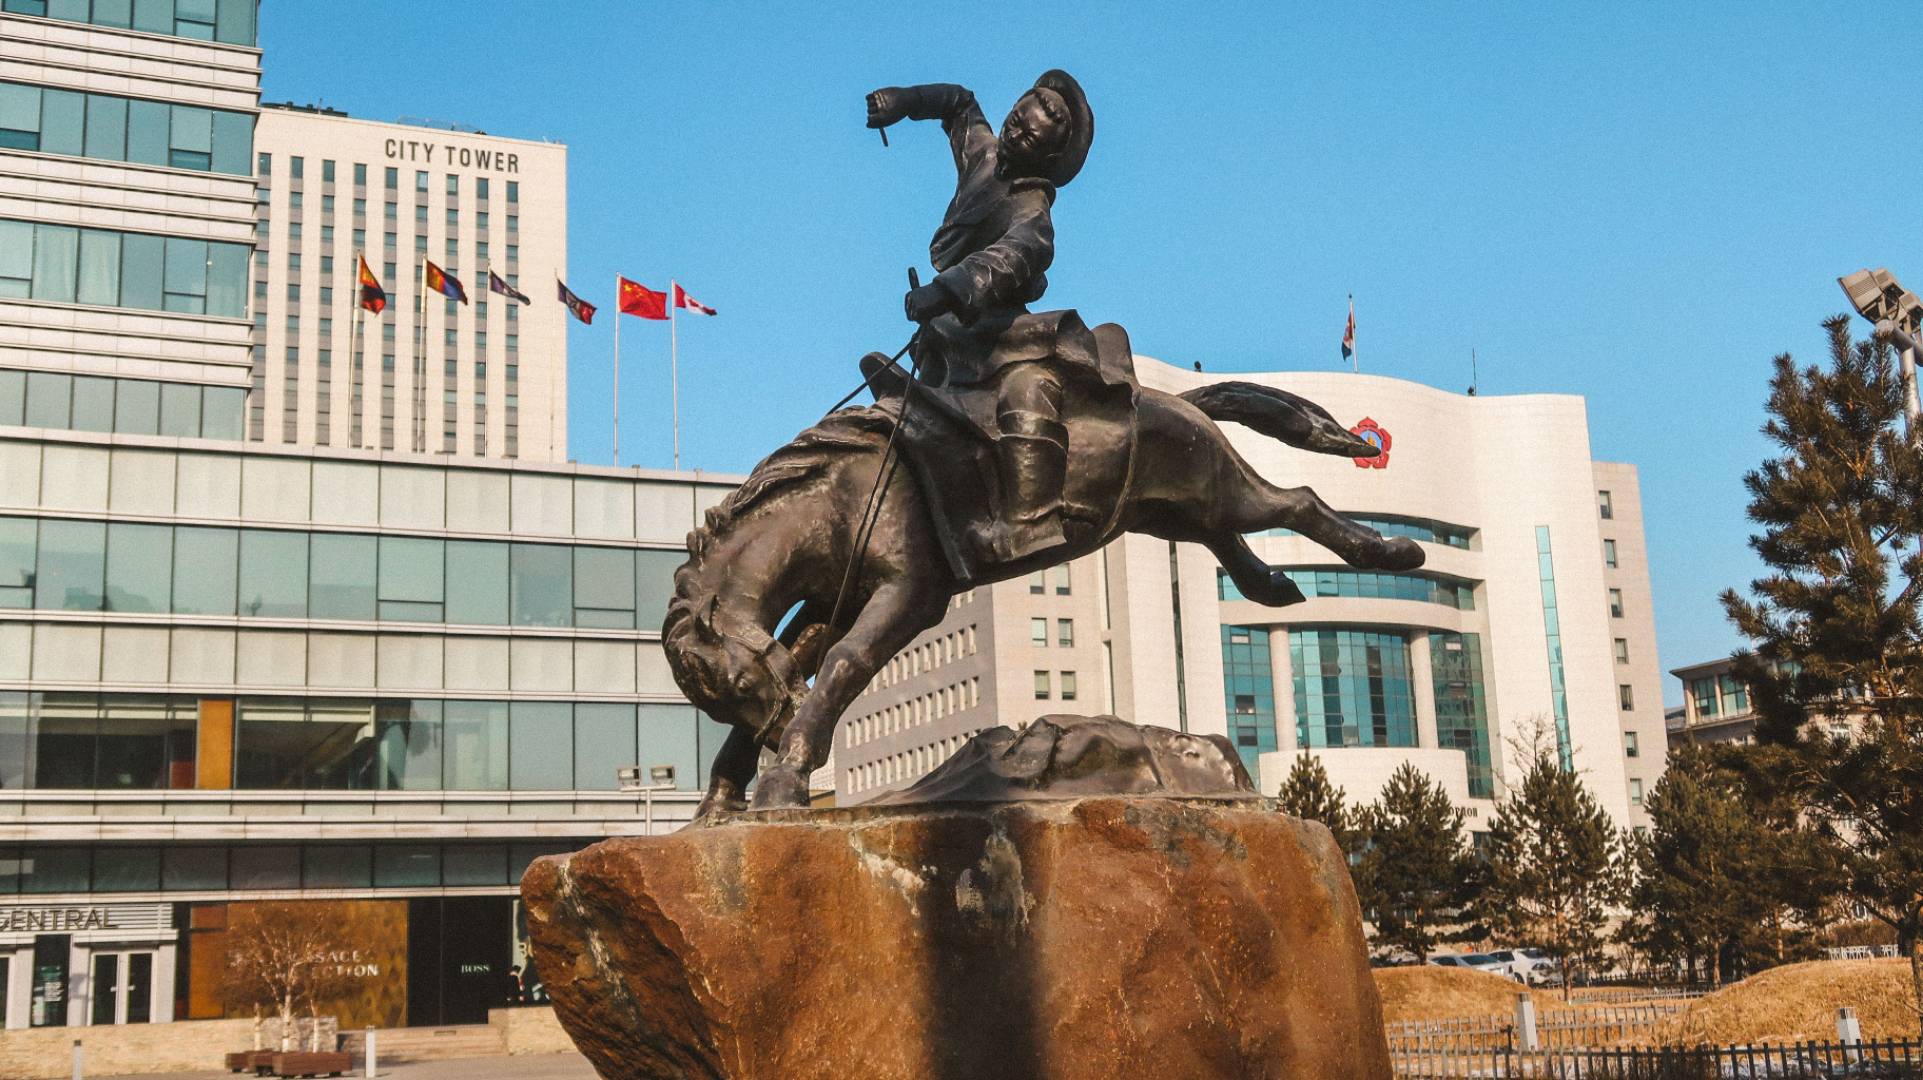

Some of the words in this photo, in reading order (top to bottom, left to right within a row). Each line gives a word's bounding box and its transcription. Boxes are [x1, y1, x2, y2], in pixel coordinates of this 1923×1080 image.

[385, 138, 434, 163] CITY
[445, 146, 519, 173] TOWER
[461, 964, 491, 974] BOSS
